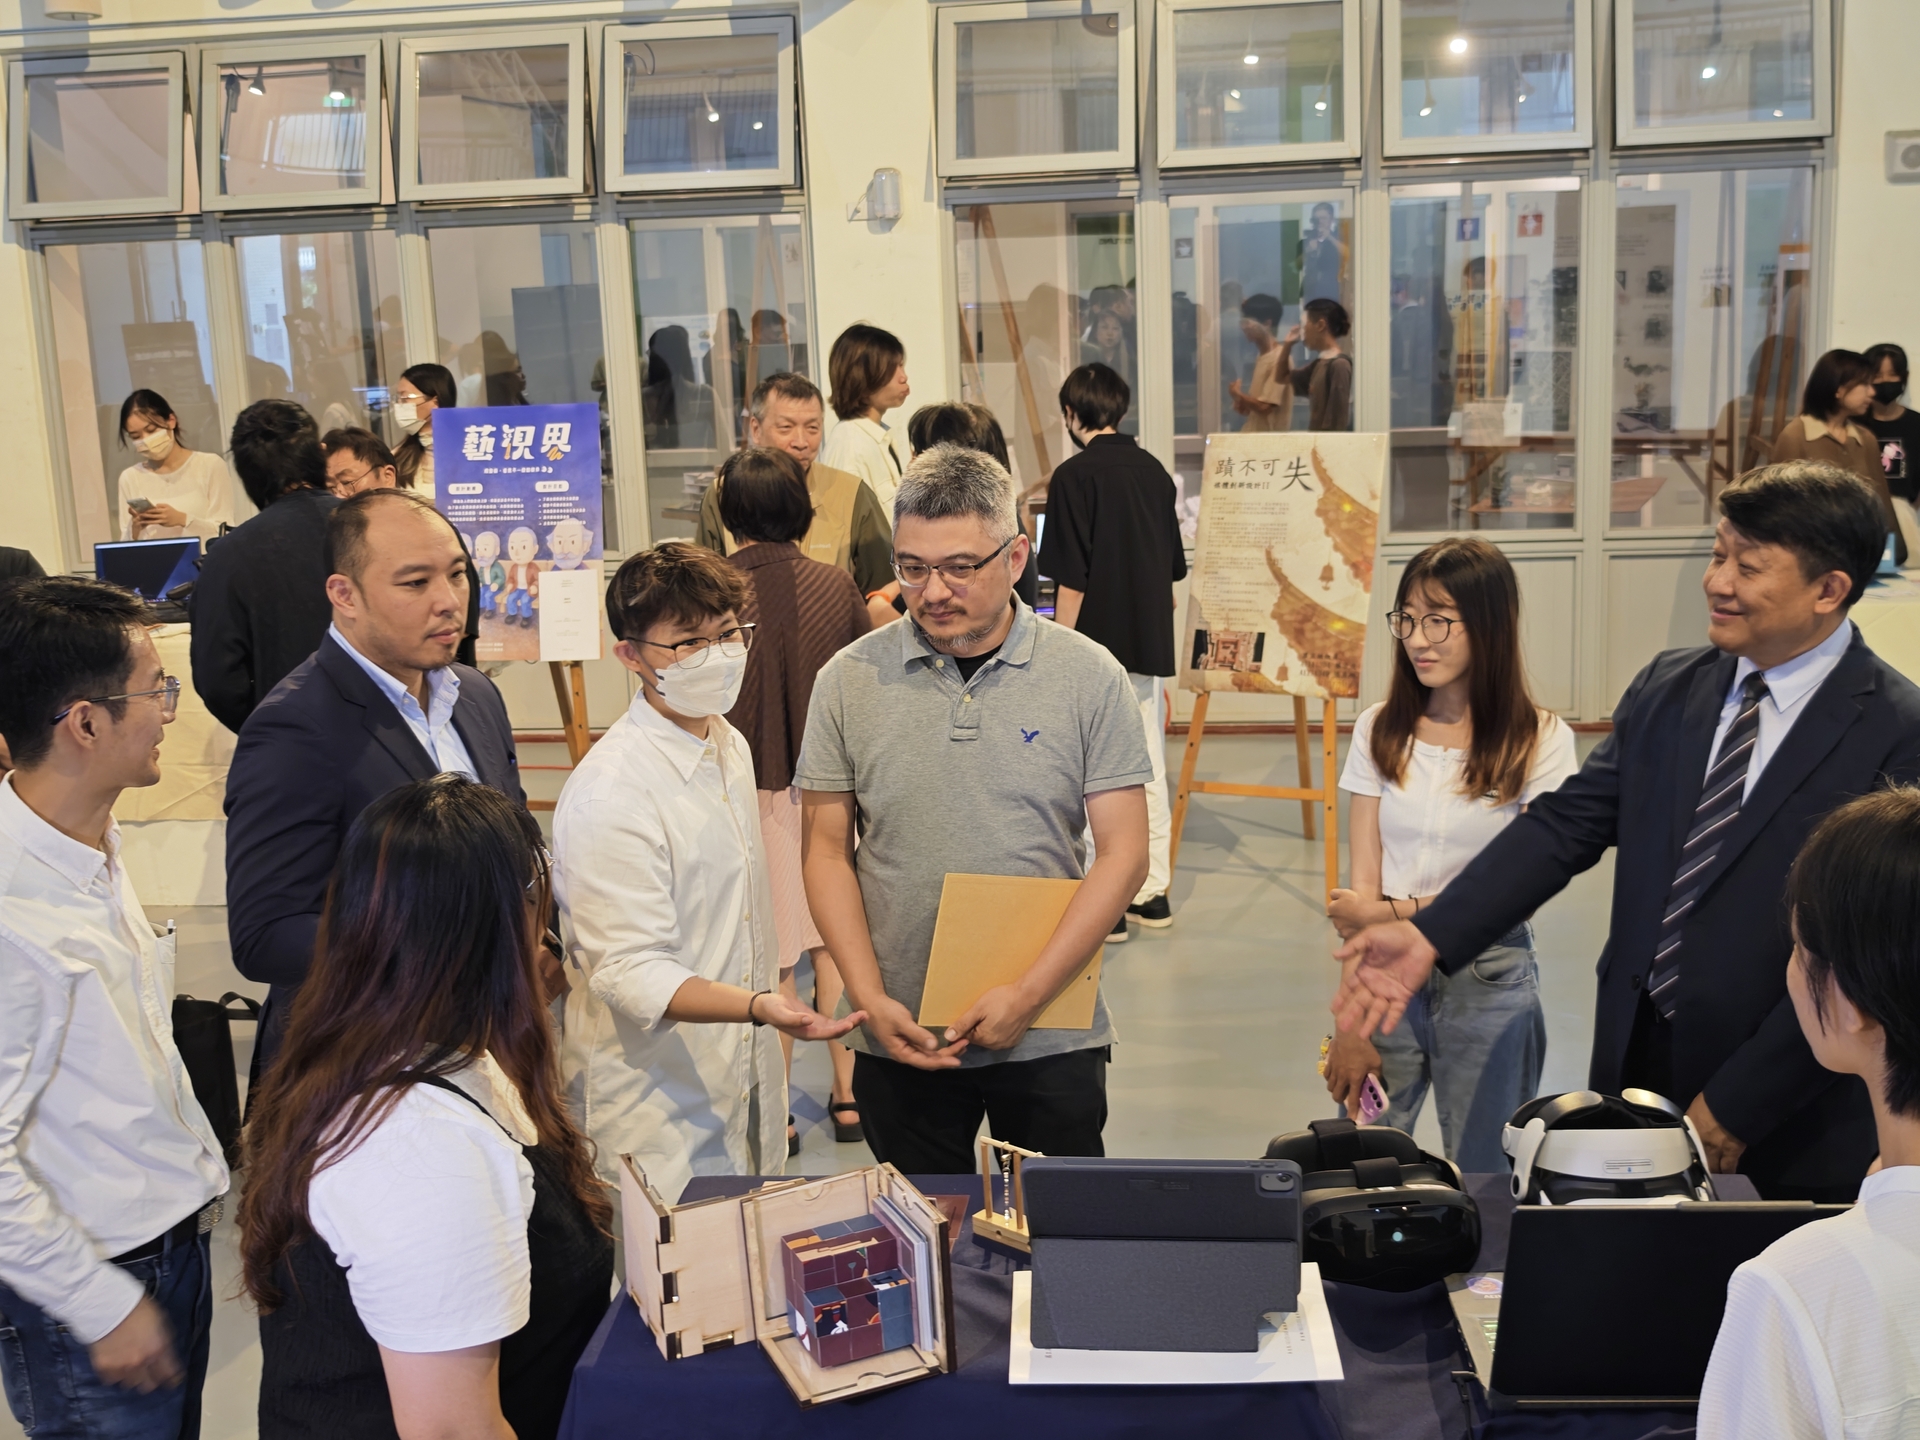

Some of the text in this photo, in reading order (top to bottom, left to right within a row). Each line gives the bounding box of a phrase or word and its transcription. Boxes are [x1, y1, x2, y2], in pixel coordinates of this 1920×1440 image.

[462, 422, 572, 461] 藝視界
[1214, 456, 1315, 493] 蹟不可失
